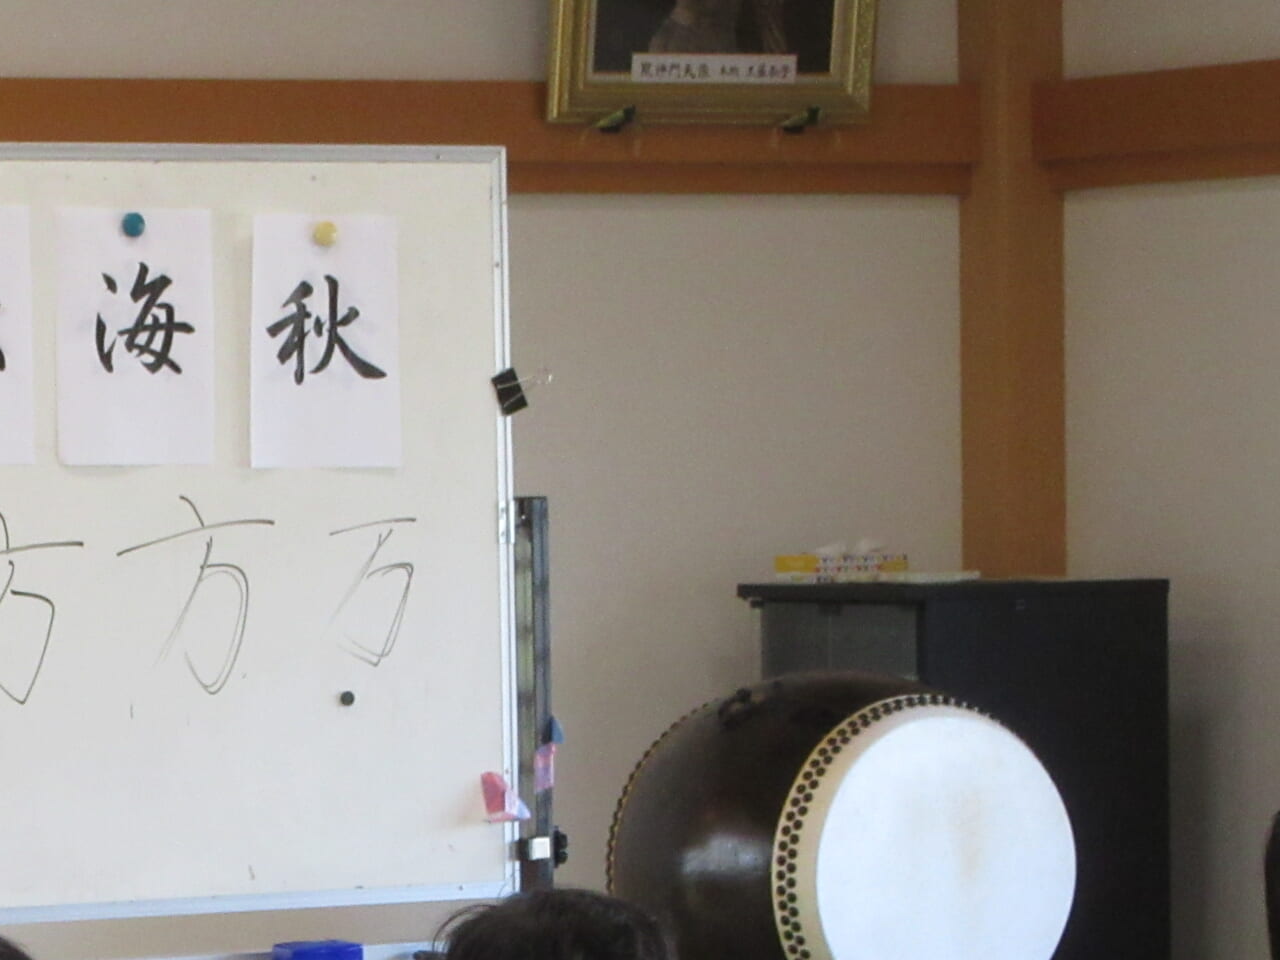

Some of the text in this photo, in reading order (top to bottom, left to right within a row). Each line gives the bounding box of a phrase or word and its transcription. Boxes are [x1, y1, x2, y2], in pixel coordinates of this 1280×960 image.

[95, 262, 195, 375] 海
[266, 274, 387, 385] 秋
[116, 495, 275, 694] 方
